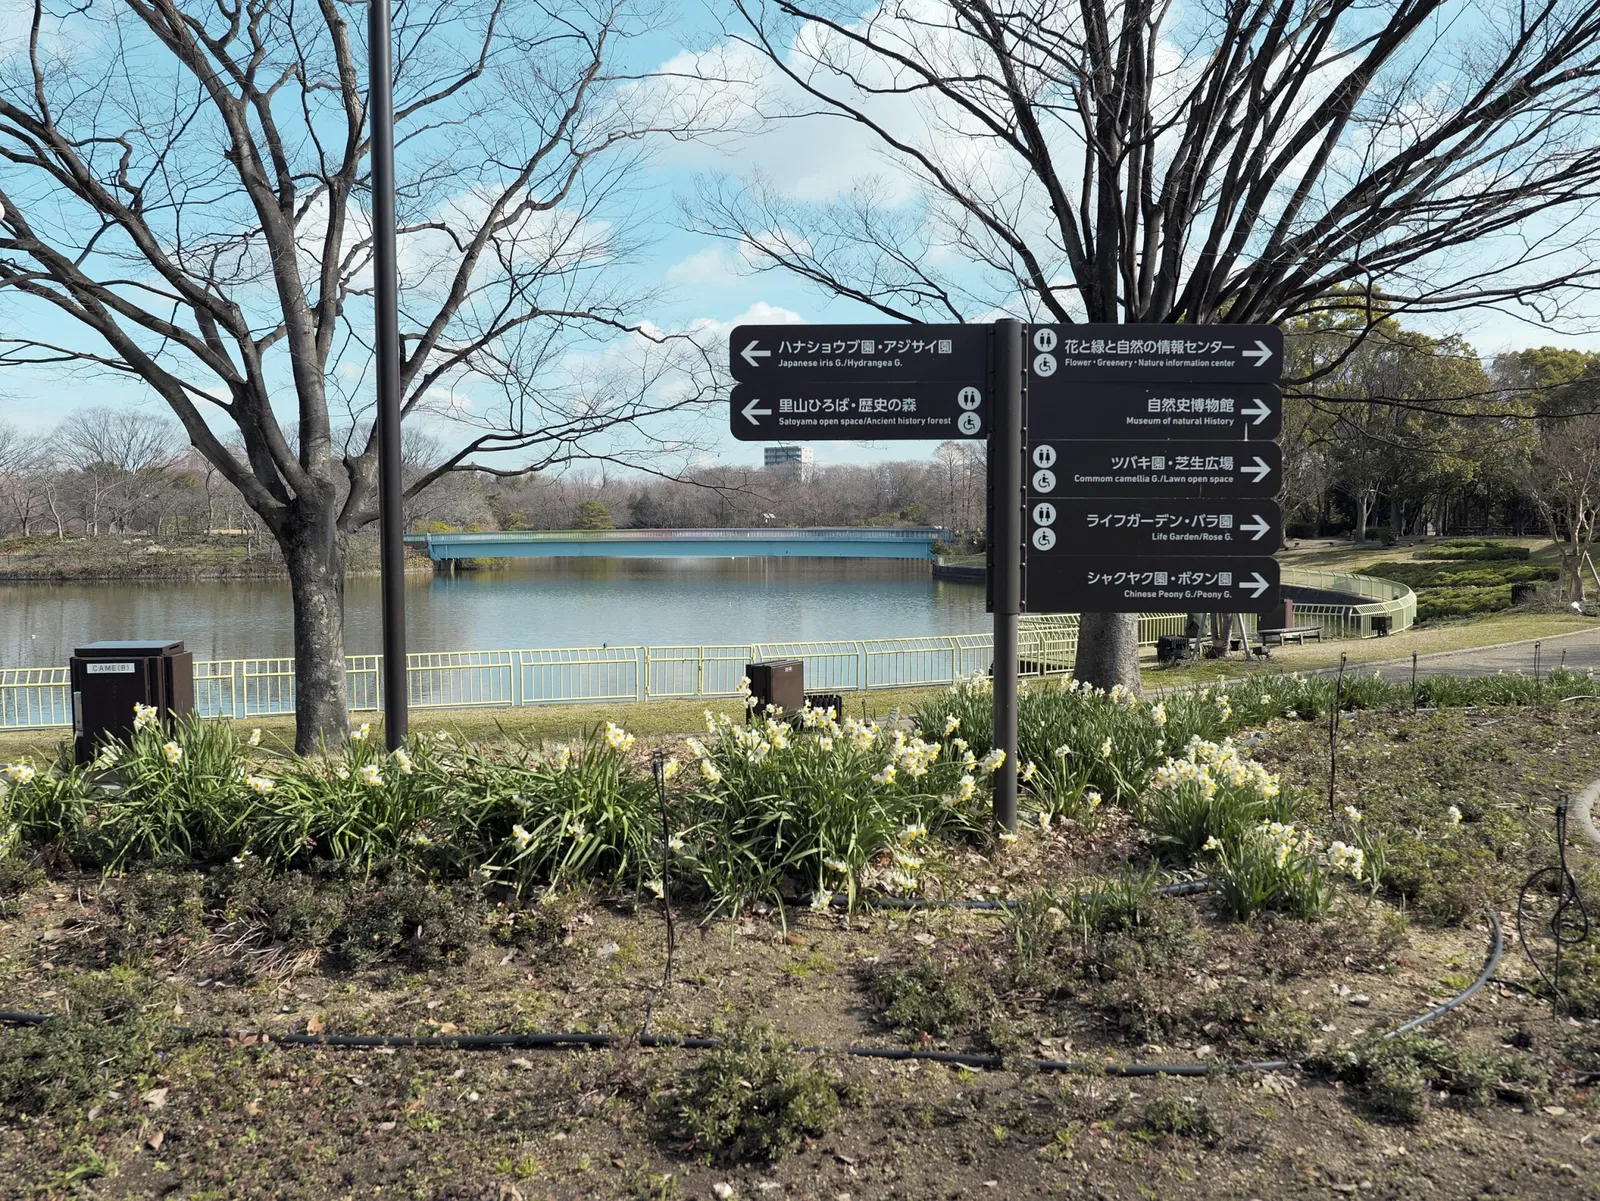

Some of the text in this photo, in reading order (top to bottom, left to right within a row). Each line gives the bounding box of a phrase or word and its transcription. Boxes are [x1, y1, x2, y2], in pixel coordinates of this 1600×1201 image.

[778, 338, 953, 355] ハナショウブ園・アジサイ園
[1064, 338, 1236, 355] 花と緑と自然の情報センター
[778, 358, 903, 369] Japanese iris G./Hydrangea G.
[1165, 358, 1210, 367] information
[1210, 358, 1236, 367] center
[778, 397, 917, 413] 里山ひろば・歴史の森
[1147, 397, 1235, 413] 自然史博物館
[778, 416, 951, 427] Satoyama open space/Ancient history forest
[1126, 416, 1235, 427] Museum of natural History
[1111, 455, 1234, 471] ツバキ園・芝生広場
[1074, 474, 1234, 485] Commom camellia G./Lawn open space
[1086, 513, 1233, 529] ライフガーデン・バラ園
[1151, 532, 1233, 541] Life Garden/Rose G.
[1087, 570, 1233, 586] シャクヤク園・ボタン園
[1124, 589, 1232, 600] Chinese Peony G./Peony G.
